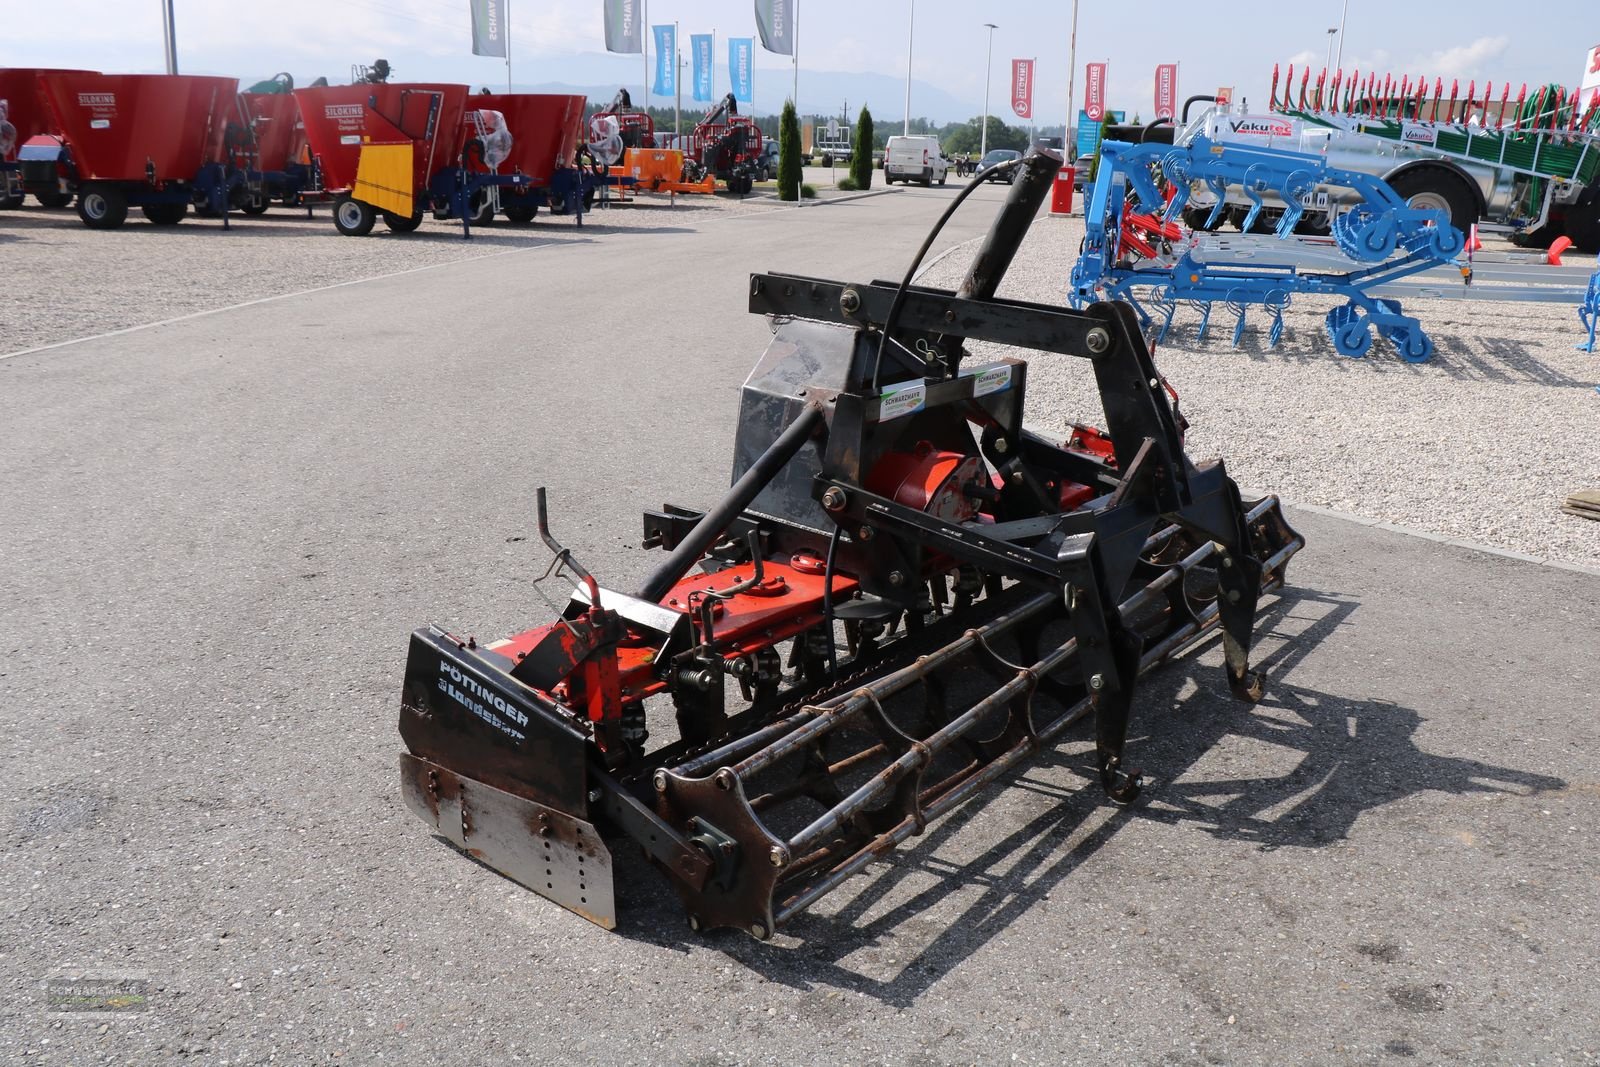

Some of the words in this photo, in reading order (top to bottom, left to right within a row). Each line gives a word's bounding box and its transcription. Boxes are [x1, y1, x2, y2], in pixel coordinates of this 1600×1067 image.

[78, 95, 115, 104] SILOKING
[325, 106, 364, 116] SILOKING
[1230, 120, 1292, 133] Vakutec
[885, 392, 920, 406] SCHWARZMAYR
[440, 660, 529, 727] PÖTTINGER
